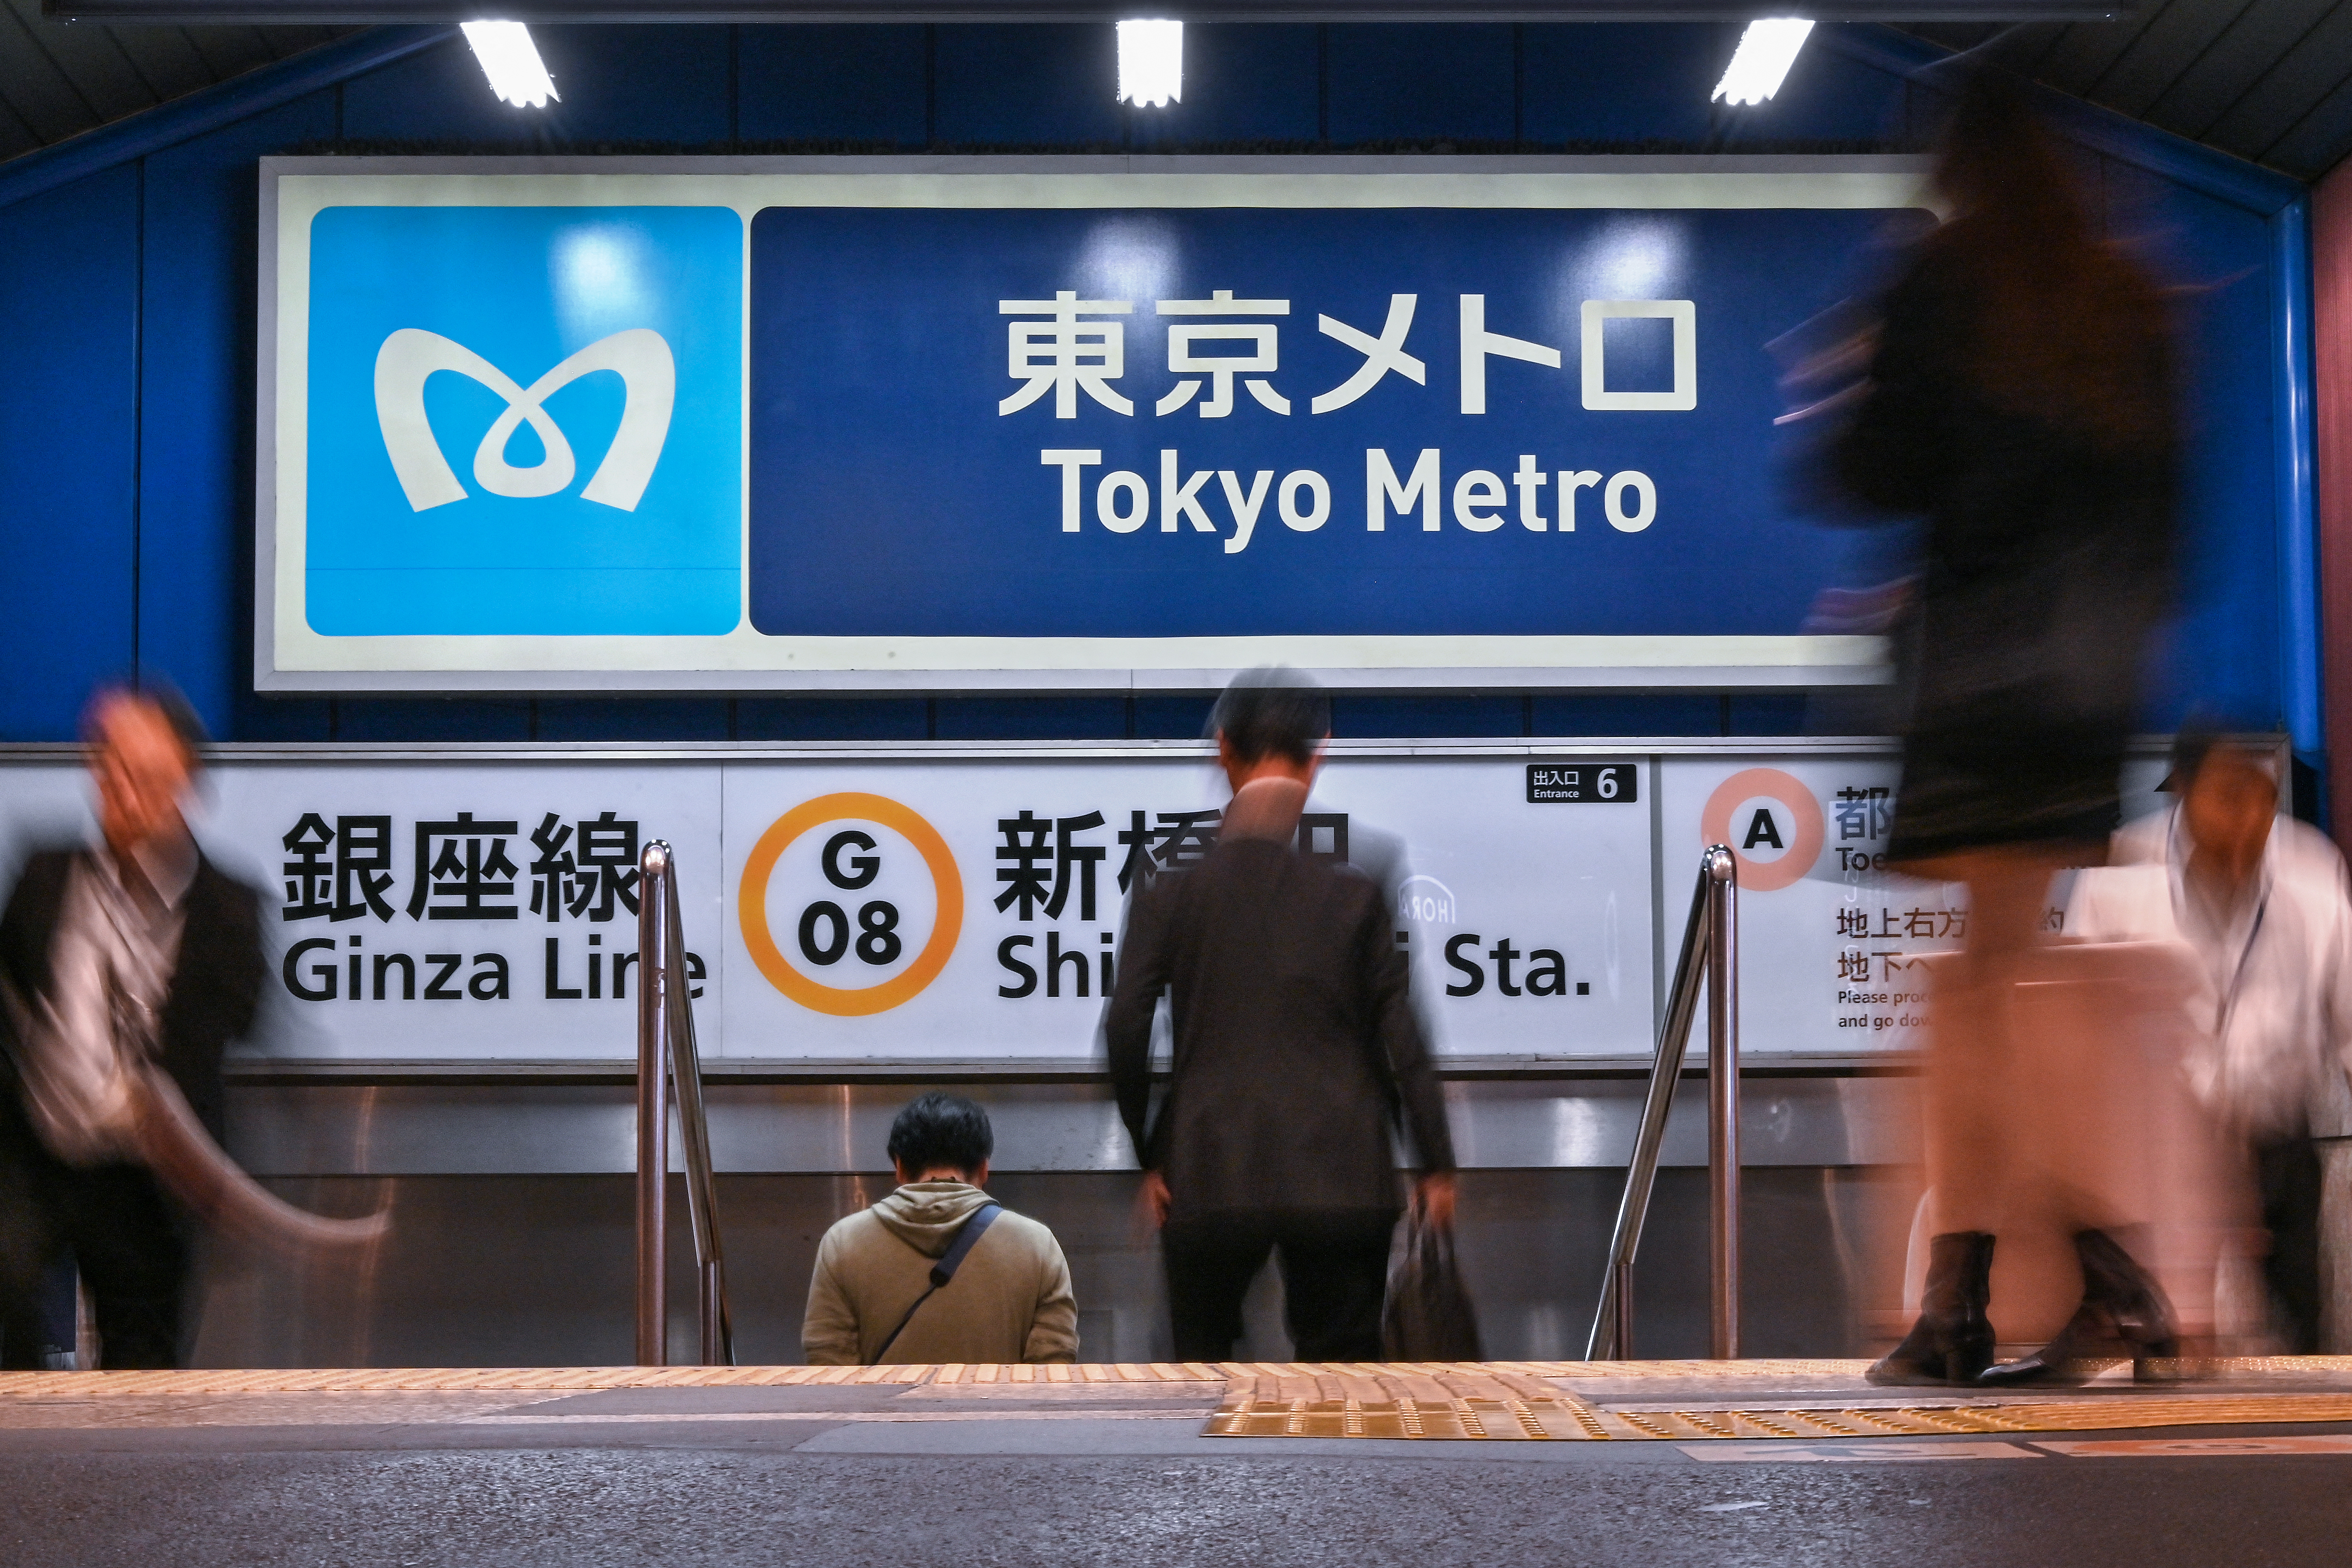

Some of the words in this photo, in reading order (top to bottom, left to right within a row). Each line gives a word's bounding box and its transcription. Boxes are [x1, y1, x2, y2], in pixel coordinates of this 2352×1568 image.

[999, 290, 1697, 419] 東京メトロ
[1041, 449, 1331, 554] Tokyo
[1366, 448, 1657, 533] Metro
[1534, 770, 1579, 785] 出入口
[1534, 789, 1579, 798] Entrance
[1597, 768, 1618, 798] 6
[1743, 809, 1783, 849] A
[1836, 786, 1891, 840] 都
[282, 811, 640, 923] 銀座線
[821, 830, 880, 890] G
[993, 808, 1349, 921] 新橋
[1835, 847, 1888, 871] Toe
[798, 900, 901, 966] 08
[282, 935, 509, 1001] Ginza
[1444, 933, 1590, 997] Sta.
[1838, 991, 1888, 1004] Please
[1838, 1014, 1867, 1027] and
[1874, 1017, 1893, 1030] go
[1900, 1014, 1934, 1027] dow
